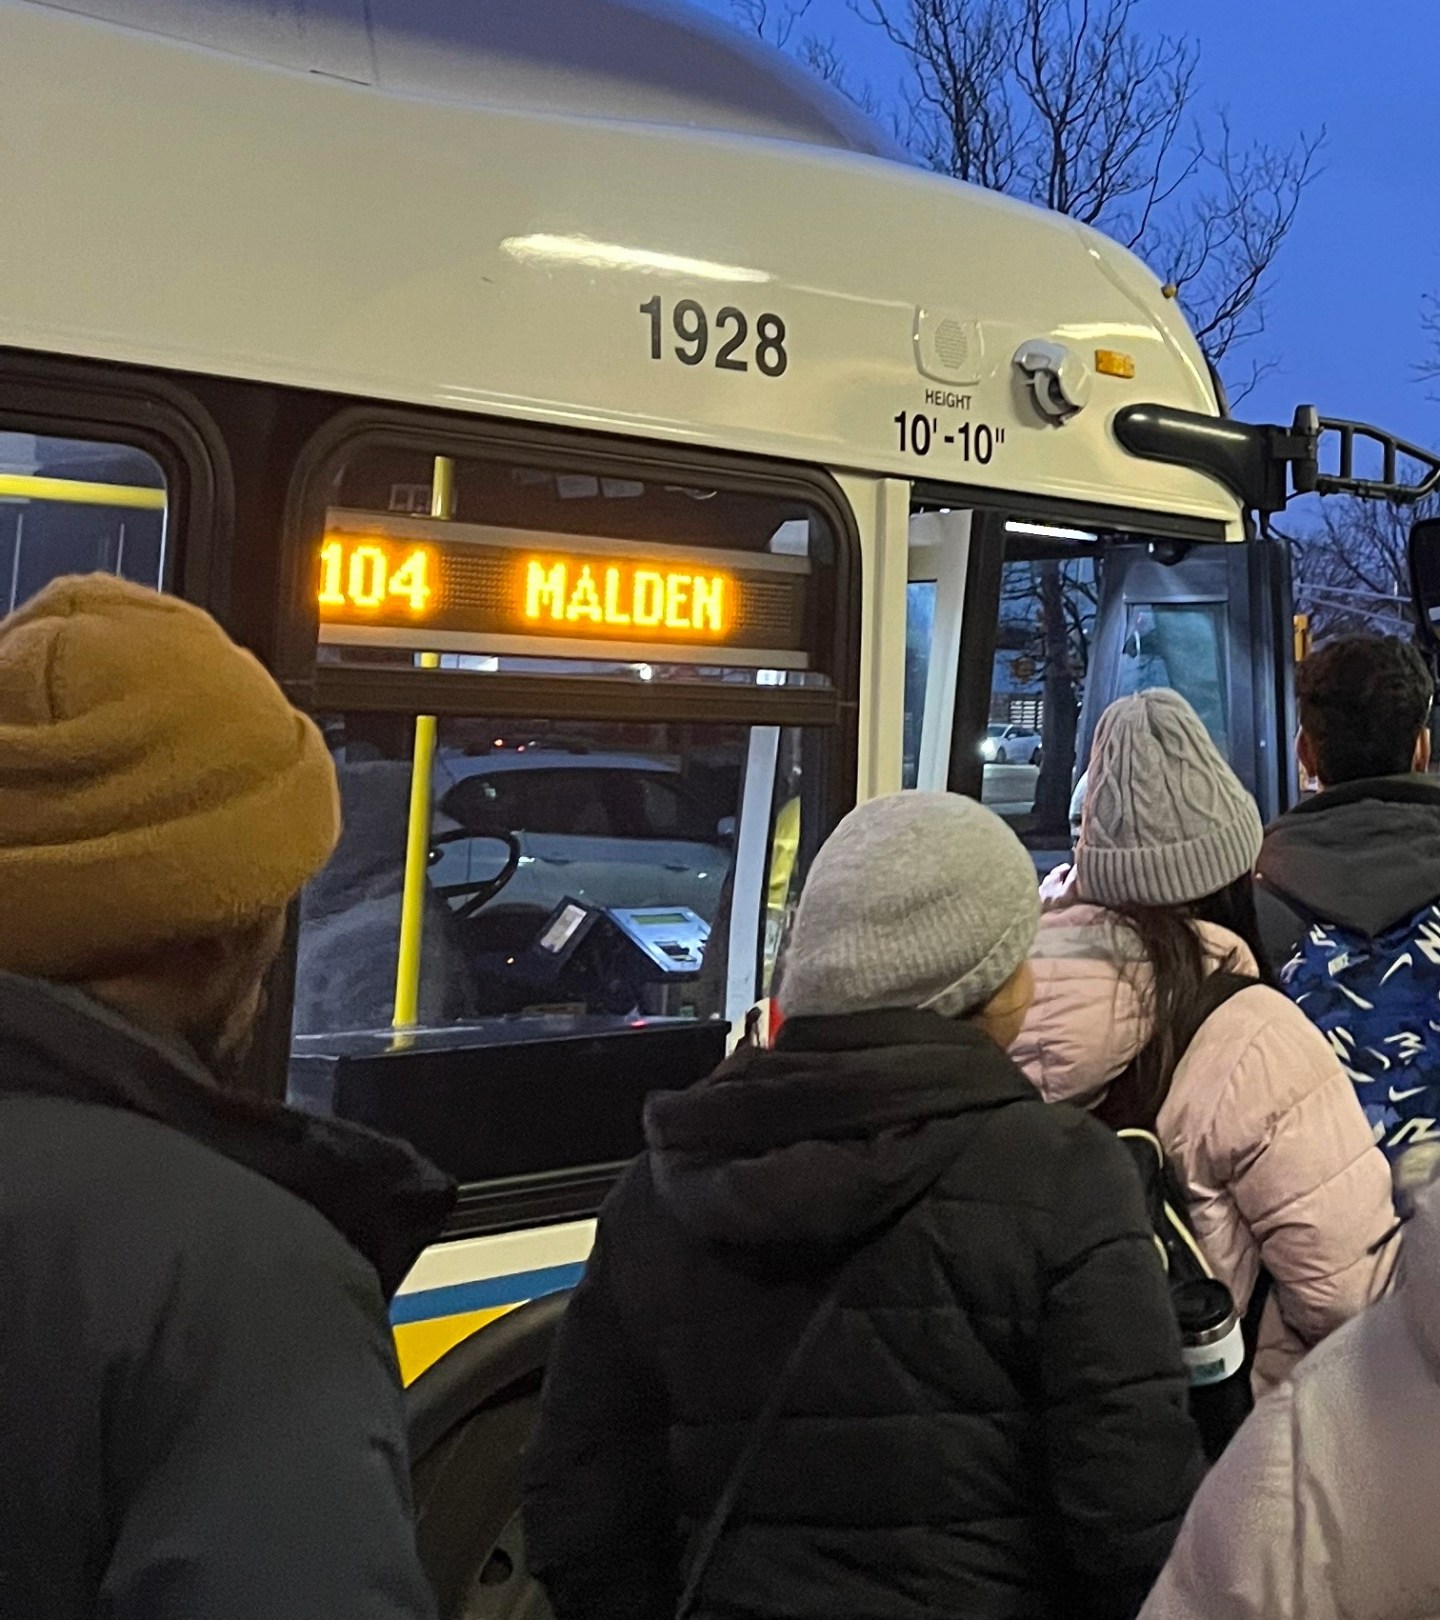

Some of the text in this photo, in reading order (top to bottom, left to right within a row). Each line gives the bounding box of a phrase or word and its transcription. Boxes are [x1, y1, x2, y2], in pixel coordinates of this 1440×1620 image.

[640, 295, 787, 377] 1928
[925, 388, 972, 410] HEIGHT
[318, 542, 724, 631] 104 MALDEN
